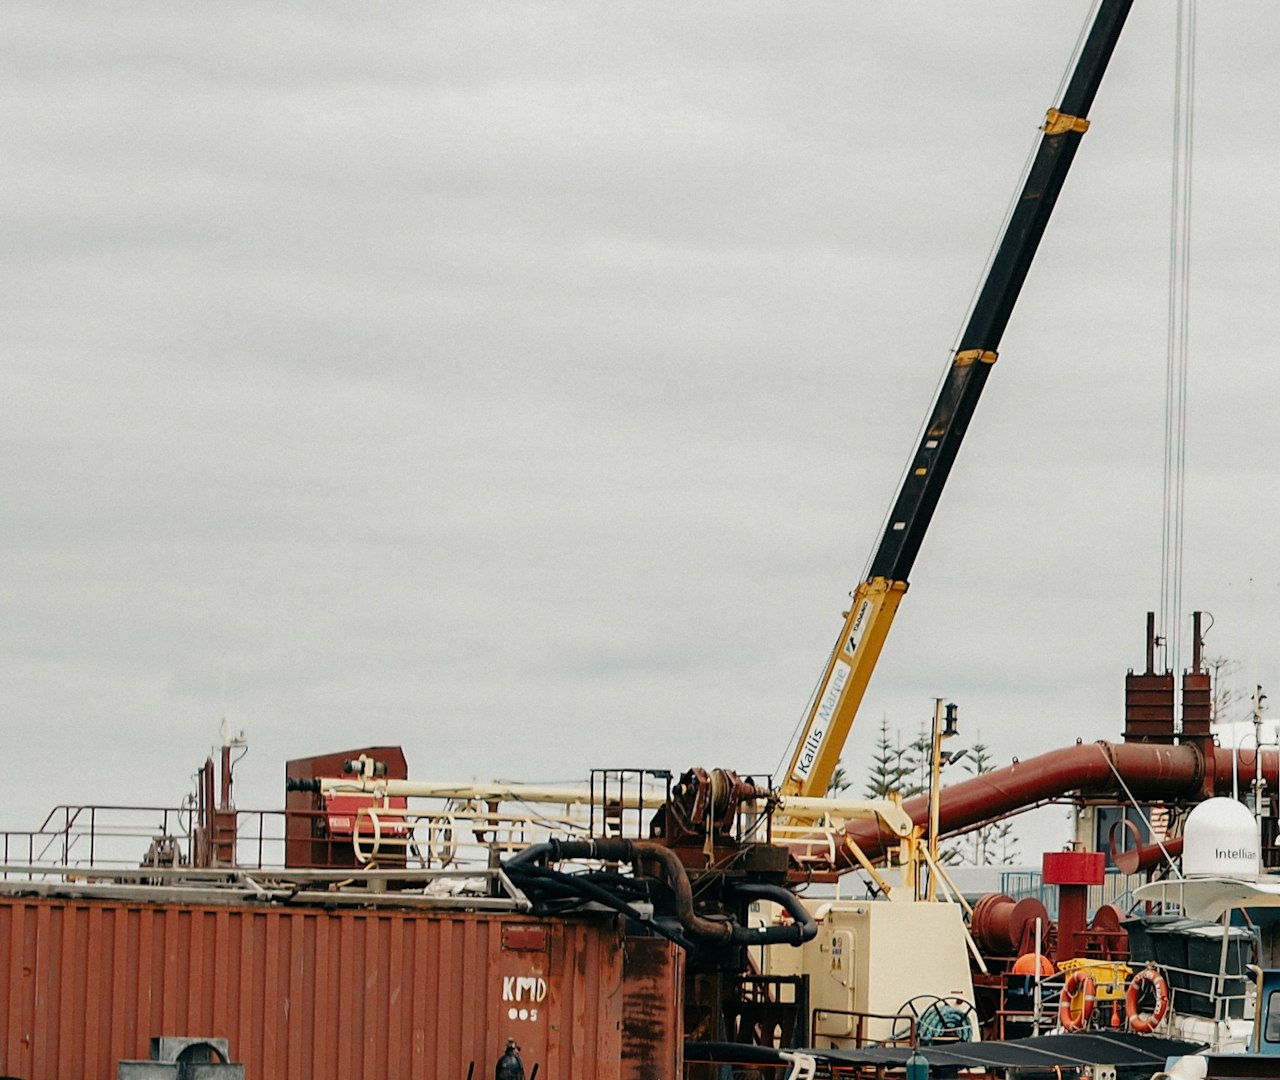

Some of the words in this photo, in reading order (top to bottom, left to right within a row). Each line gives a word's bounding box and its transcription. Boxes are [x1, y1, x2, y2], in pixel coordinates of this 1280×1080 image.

[853, 600, 869, 632] TADANO
[798, 728, 824, 774] Kailis
[818, 667, 848, 722] Marine
[502, 976, 547, 1002] KMD
[508, 1008, 538, 1022] 005
